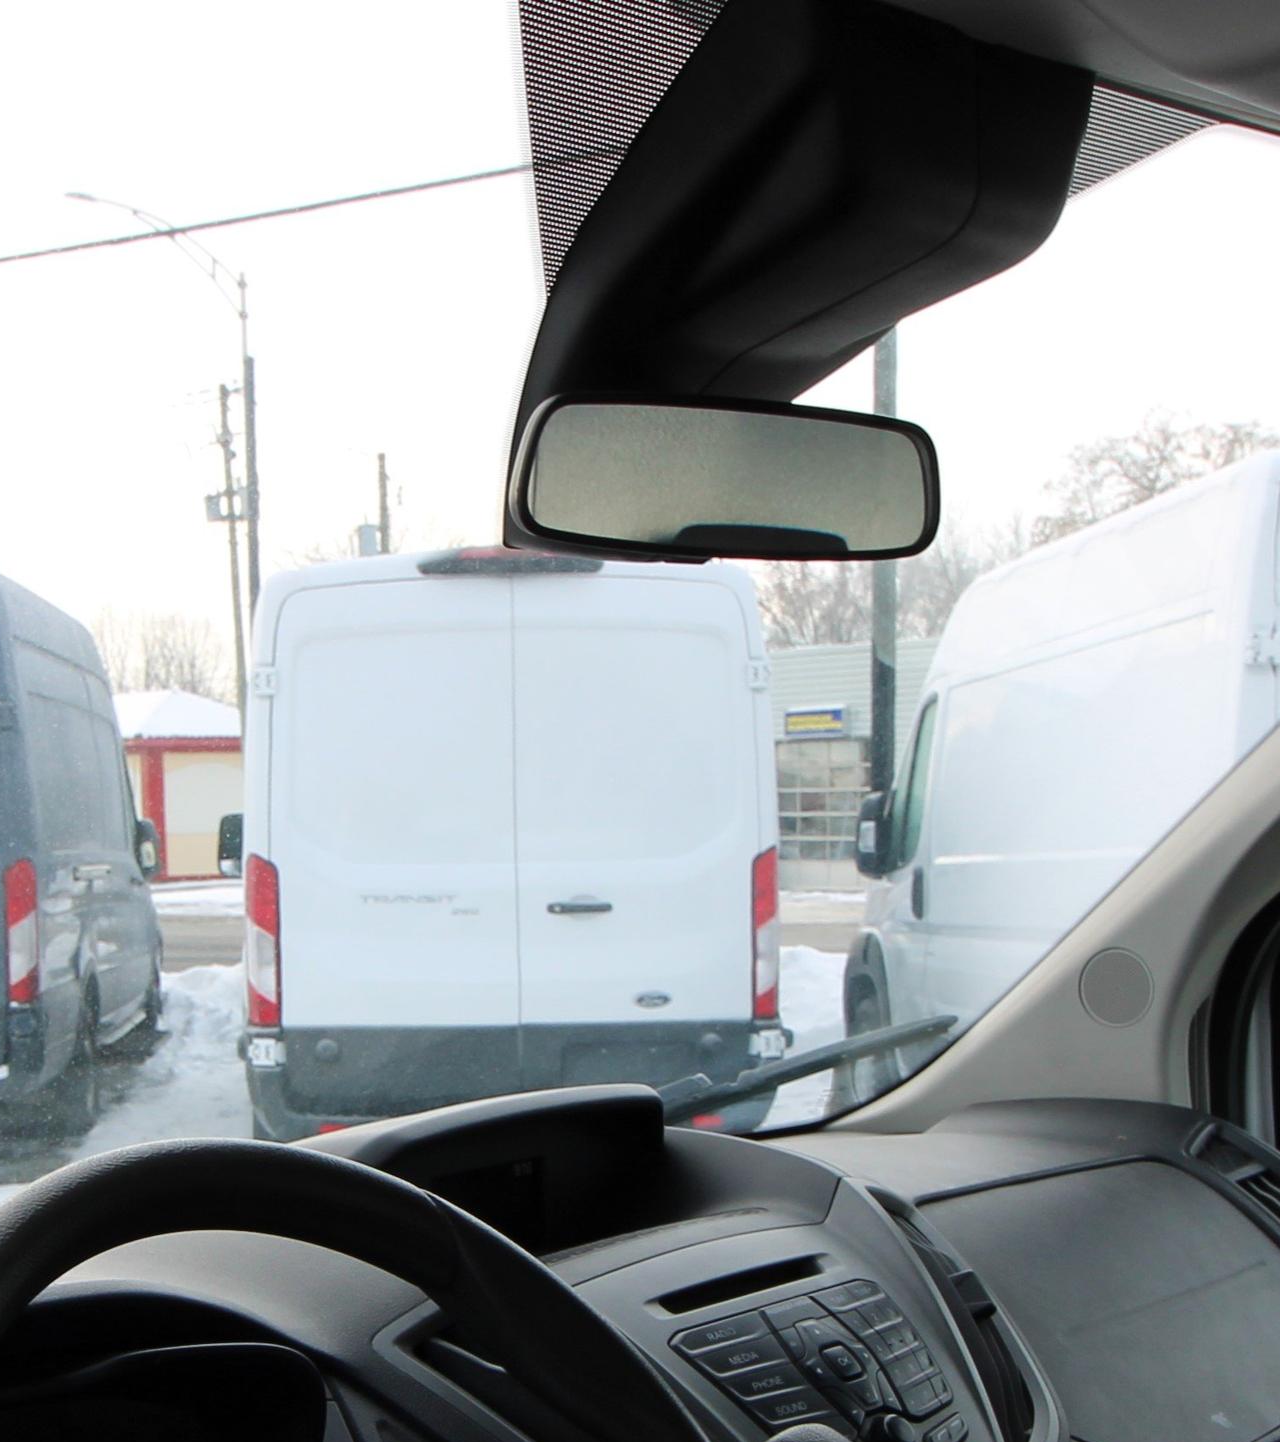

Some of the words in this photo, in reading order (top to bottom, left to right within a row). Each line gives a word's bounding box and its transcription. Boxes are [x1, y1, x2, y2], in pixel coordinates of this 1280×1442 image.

[706, 1327, 736, 1342] RADIO
[728, 1351, 760, 1366] MEDIA
[751, 1376, 784, 1391] PHONE
[775, 1401, 808, 1416] SOUND
